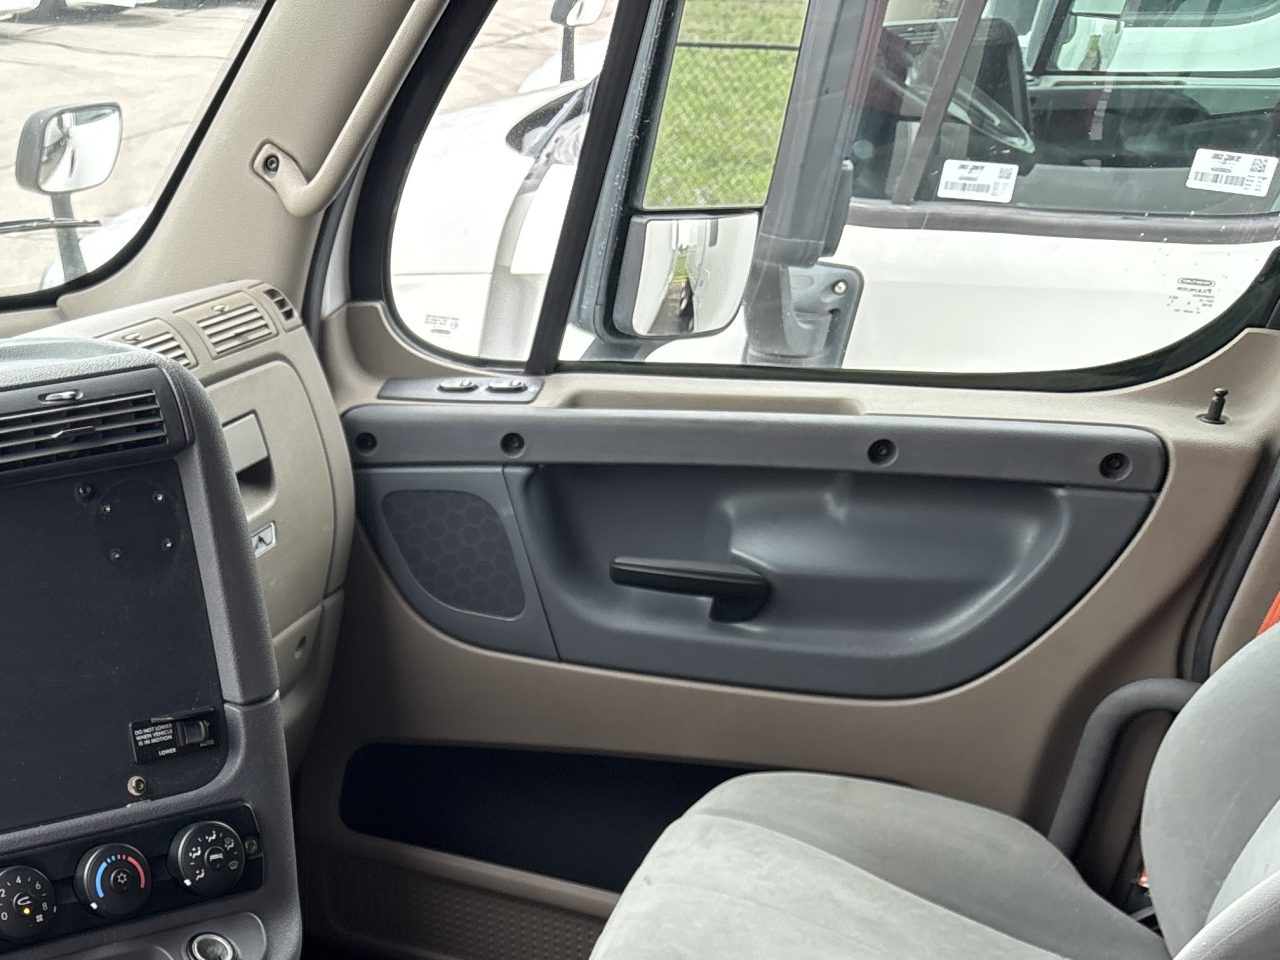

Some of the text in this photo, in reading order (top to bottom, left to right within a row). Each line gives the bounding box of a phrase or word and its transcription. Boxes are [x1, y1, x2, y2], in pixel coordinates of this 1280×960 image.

[134, 728, 143, 736] DO
[155, 723, 172, 731] LOWER
[15, 875, 22, 884] 4
[35, 881, 42, 890] 6
[0, 888, 6, 897] 2
[42, 902, 48, 911] 8
[1, 911, 8, 921] 0
